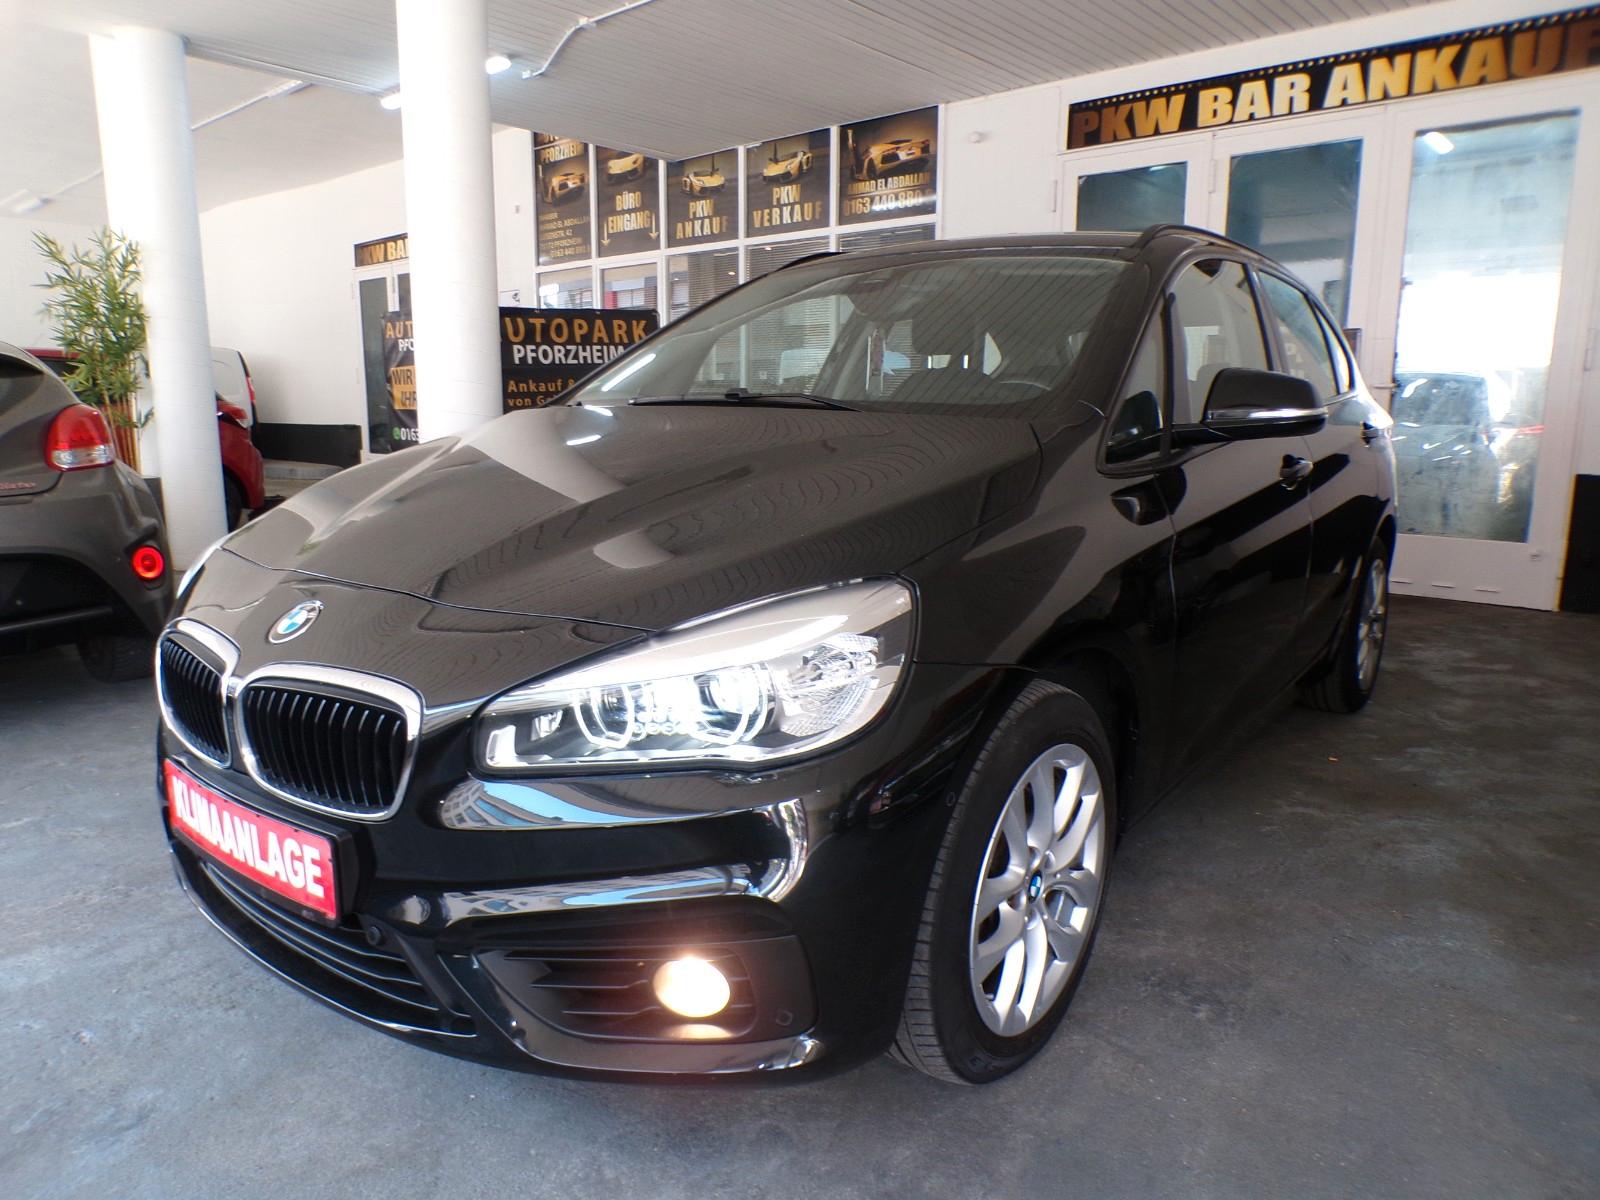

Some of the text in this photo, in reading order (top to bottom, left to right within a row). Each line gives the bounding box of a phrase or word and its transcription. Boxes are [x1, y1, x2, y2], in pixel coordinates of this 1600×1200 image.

[1070, 20, 1600, 148] PKW BAR ANKAUF
[877, 178, 886, 191] EL
[615, 191, 642, 210] BÜRO
[772, 183, 801, 206] PKW
[688, 199, 714, 218] PKW
[753, 200, 823, 228] VERKAUF
[843, 197, 871, 216] 0163
[607, 210, 652, 234] EINGANG
[675, 216, 728, 240] ANKAUF
[392, 367, 413, 385] WIR
[507, 378, 563, 393] Ankauf
[507, 397, 532, 407] von
[171, 774, 325, 899] KLIMAANLAGE
